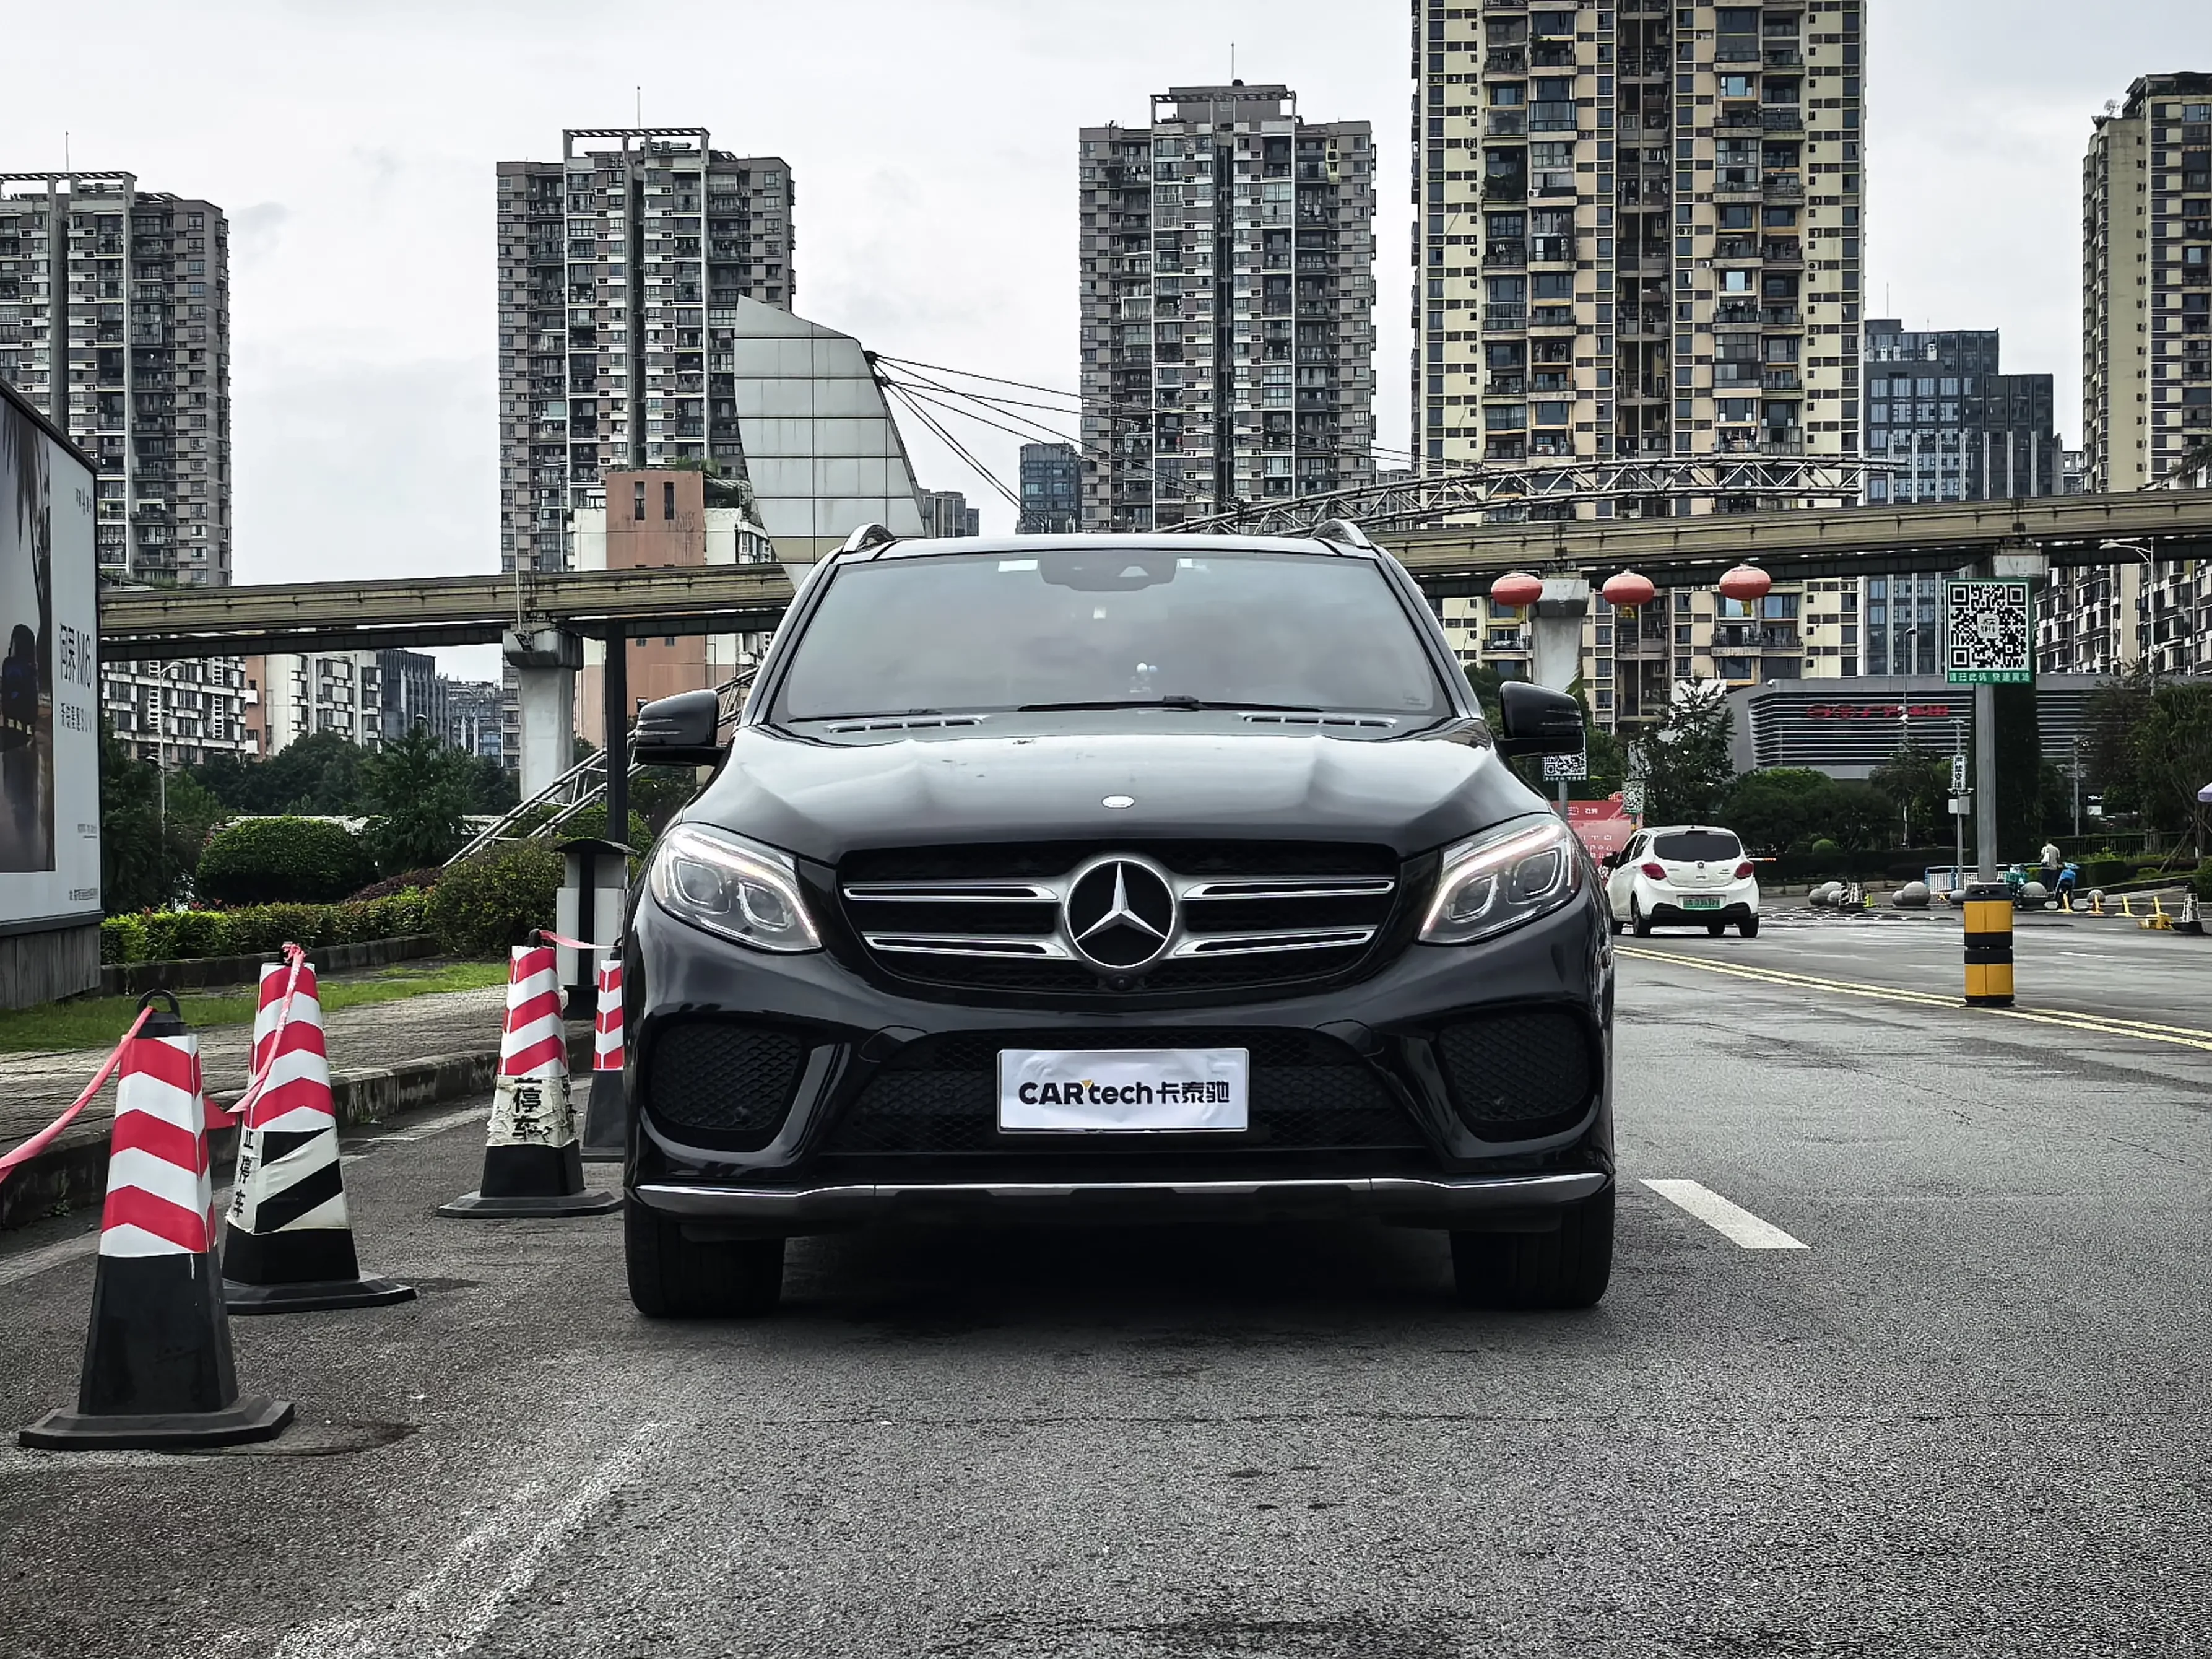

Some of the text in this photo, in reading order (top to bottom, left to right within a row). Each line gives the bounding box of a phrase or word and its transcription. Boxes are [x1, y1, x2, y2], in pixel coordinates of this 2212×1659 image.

[512, 1078, 543, 1142] 停车
[1018, 1081, 1230, 1105] CARtech 卡泰驰
